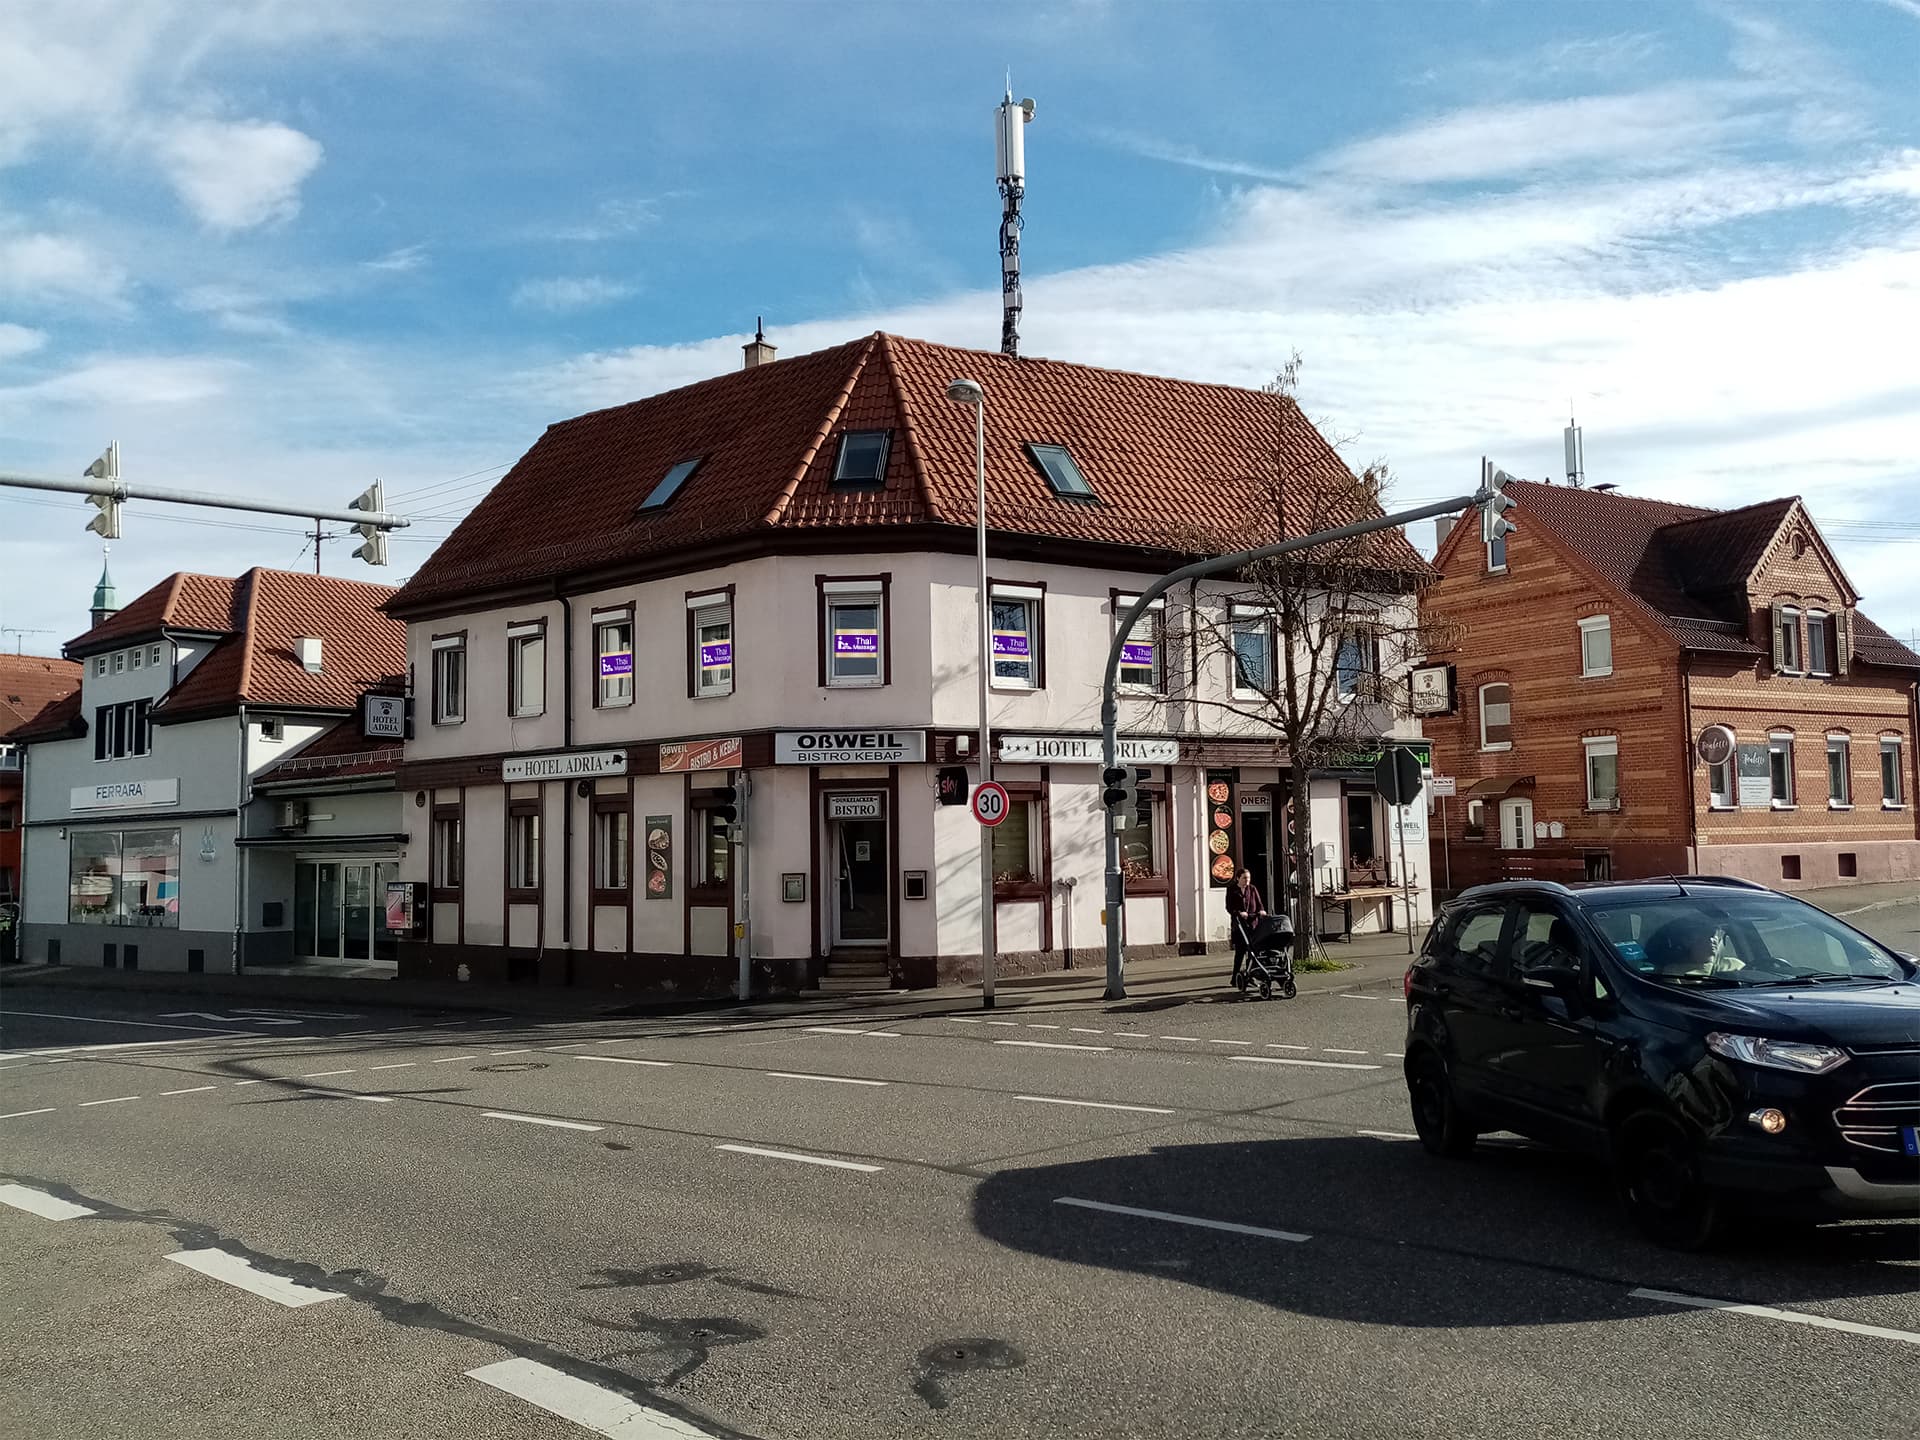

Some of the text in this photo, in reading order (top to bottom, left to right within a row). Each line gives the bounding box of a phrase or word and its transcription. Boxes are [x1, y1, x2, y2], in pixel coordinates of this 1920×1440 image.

[855, 637, 872, 645] Thai
[1010, 639, 1025, 648] Thai
[715, 646, 728, 656] Thai
[615, 656, 629, 665] Thai
[373, 716, 397, 724] HOTEL
[373, 724, 398, 732] ADRIA
[1035, 740, 1092, 757] HOTEL
[690, 750, 713, 770] BISTRO
[797, 751, 903, 762] BISTRO KEBAP
[525, 755, 603, 777] HOTEL ADRIA
[96, 783, 144, 800] FERRARA
[941, 775, 959, 799] sky
[979, 793, 1001, 814] 30
[834, 804, 876, 816] BISTRO
